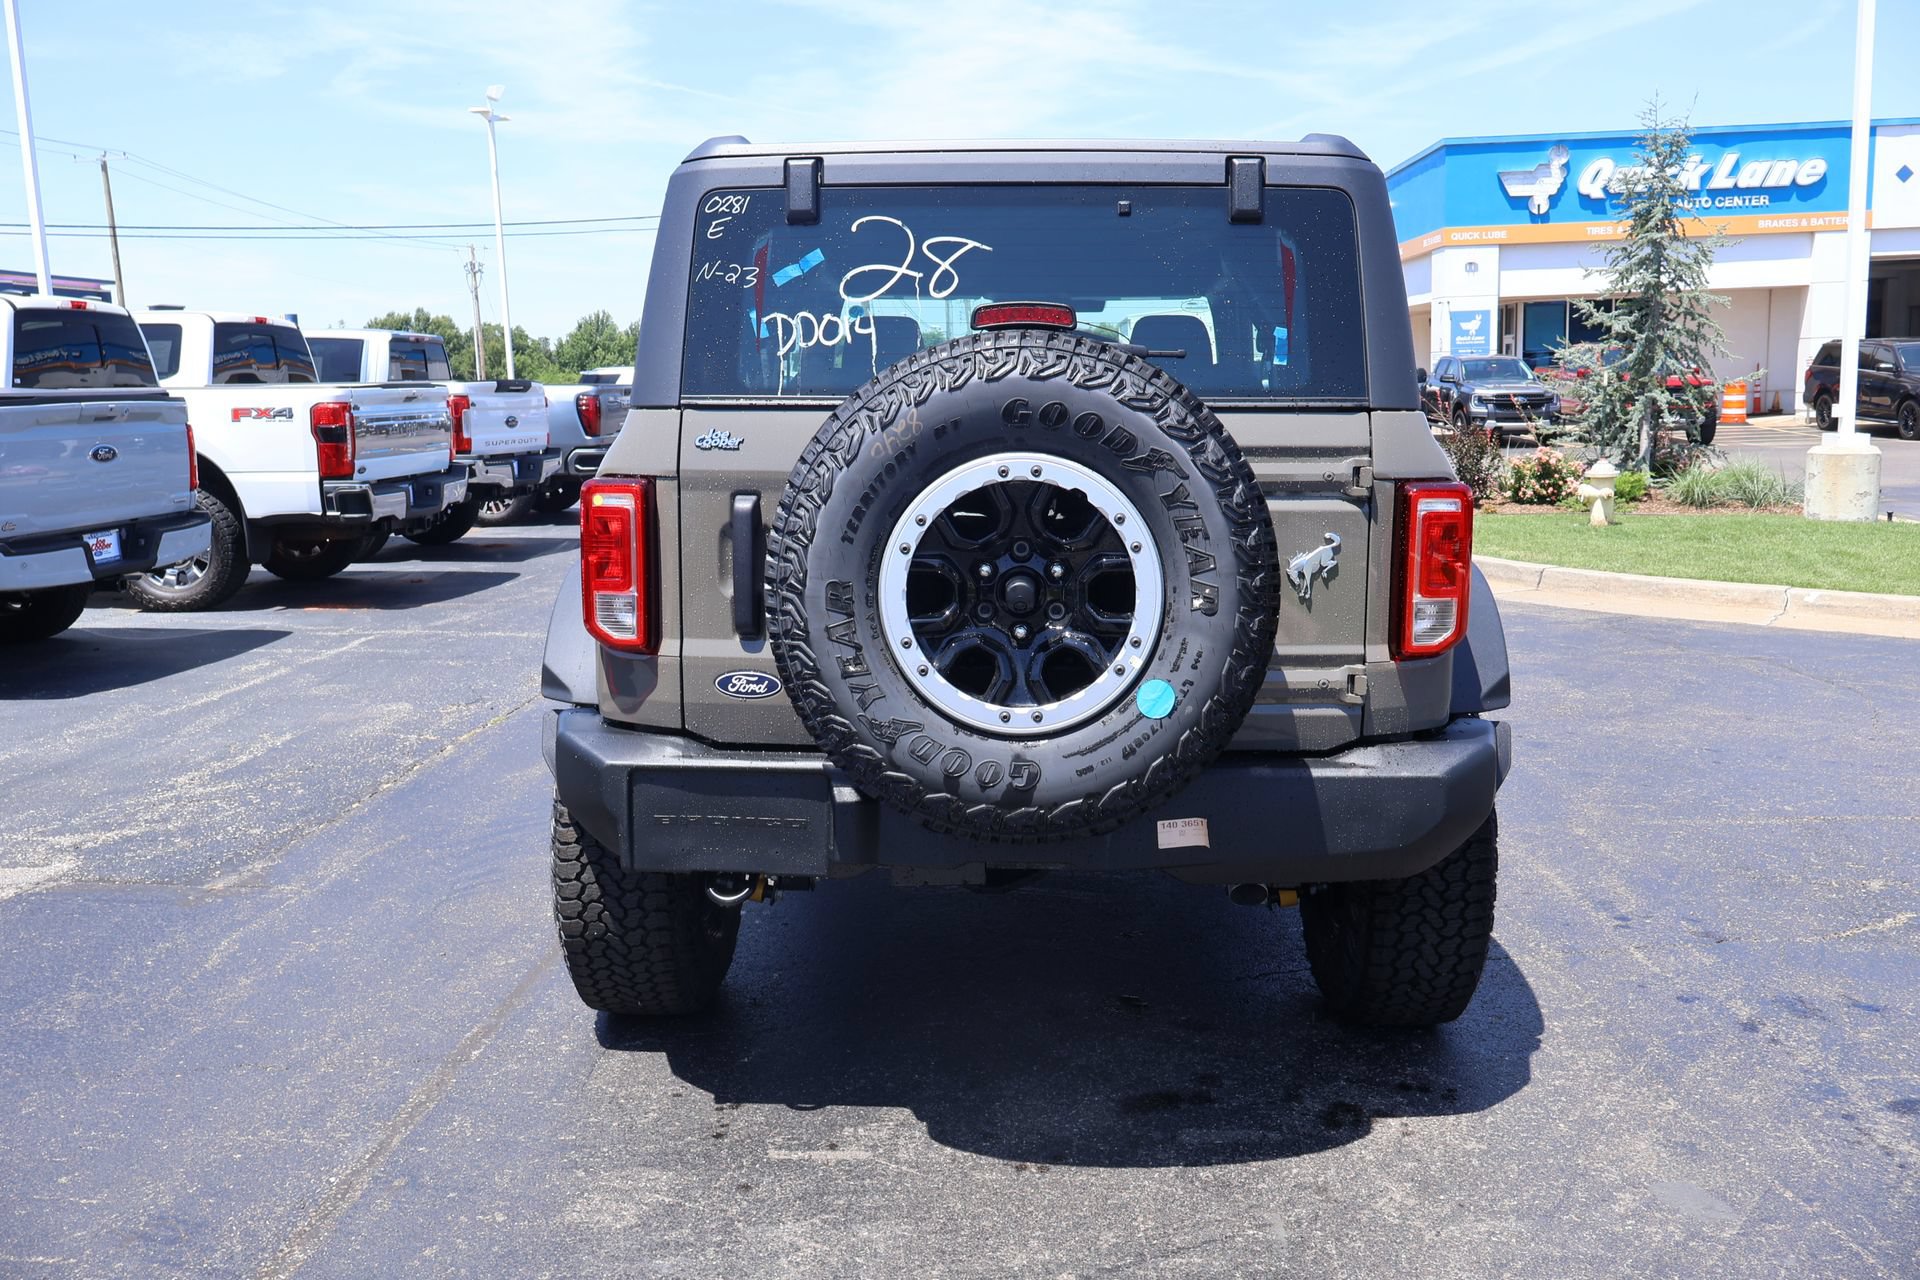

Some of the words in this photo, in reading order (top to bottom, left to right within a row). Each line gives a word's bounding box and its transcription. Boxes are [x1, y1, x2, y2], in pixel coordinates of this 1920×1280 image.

[1706, 152, 1828, 190] Lane
[705, 195, 750, 214] 0281
[1675, 196, 1713, 209] AUTO
[1714, 195, 1770, 208] CENTER
[707, 216, 732, 239] E
[1758, 219, 1798, 228] BRAKES
[1800, 218, 1808, 227] &
[1810, 217, 1848, 226] BATTER
[1451, 231, 1480, 241] QUICK
[1482, 230, 1508, 239] LUBE
[1586, 226, 1614, 235] TIRES
[839, 215, 993, 301] 28
[695, 260, 760, 289] N-23
[231, 407, 294, 423] FX4
[707, 428, 731, 439] Joe
[484, 439, 516, 447] SUPER
[695, 434, 745, 449] Cooper
[840, 441, 917, 545] TERRITORY
[727, 672, 768, 695] Ford
[1162, 821, 1178, 830] 140
[1181, 819, 1205, 829] 3651
